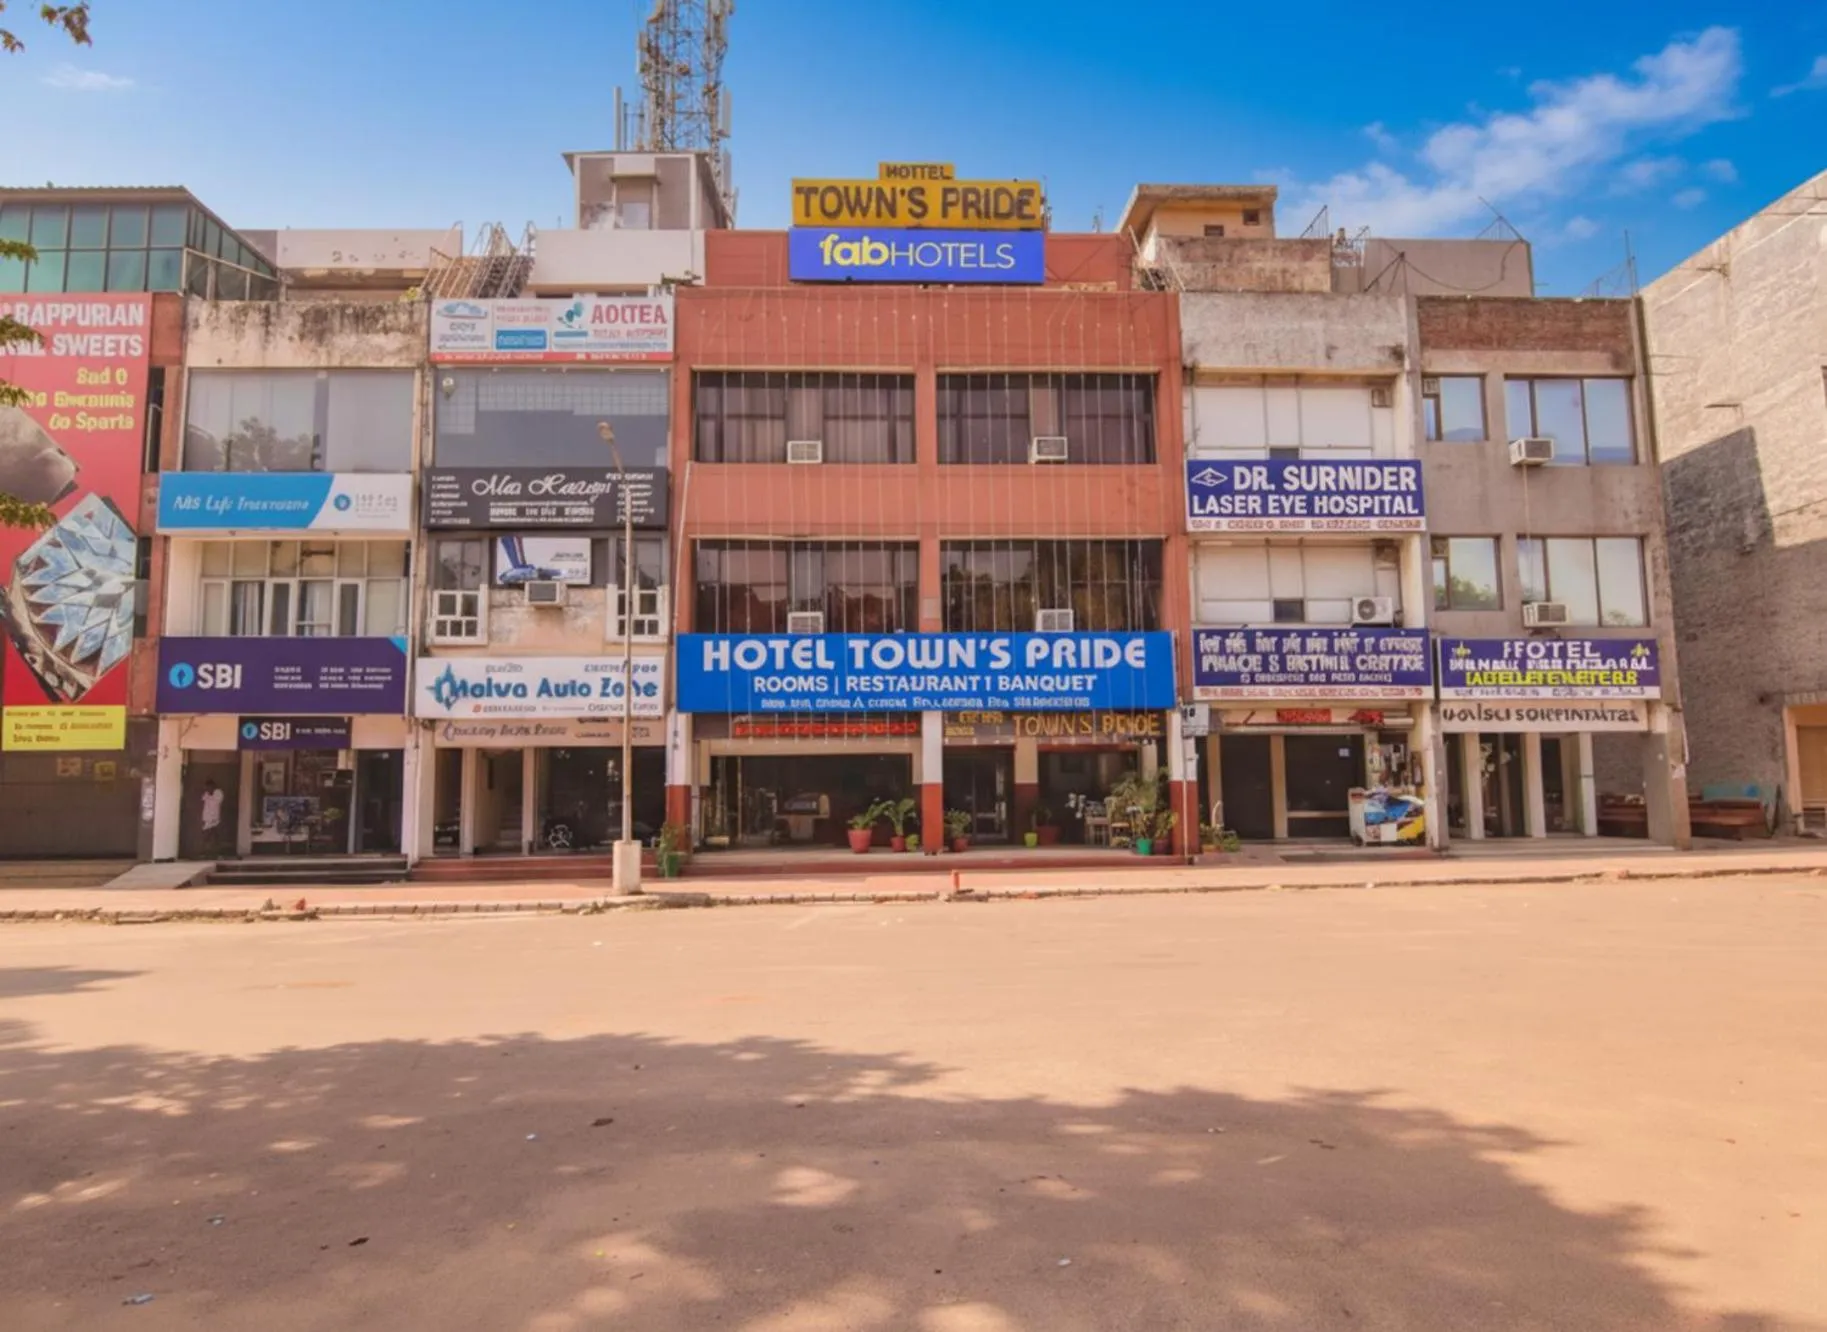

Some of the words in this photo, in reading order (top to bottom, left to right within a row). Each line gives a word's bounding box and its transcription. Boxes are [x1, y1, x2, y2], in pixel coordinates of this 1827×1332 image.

[795, 184, 928, 220] TOWN'S
[941, 187, 1037, 220] PRIDE
[1233, 465, 1275, 491] DR.
[1192, 495, 1262, 514] LASER
[1268, 495, 1308, 514] EYE
[1313, 495, 1419, 514] HOSPITAL
[703, 639, 834, 671] HOTEL
[848, 638, 1012, 670] TOWN'S
[1026, 638, 1146, 669] PRIDE
[197, 663, 242, 690] SBI
[754, 675, 829, 693] ROOMS
[846, 675, 980, 693] RESTAURANT
[998, 675, 1097, 692] BANQUET
[260, 722, 291, 741] SBI
